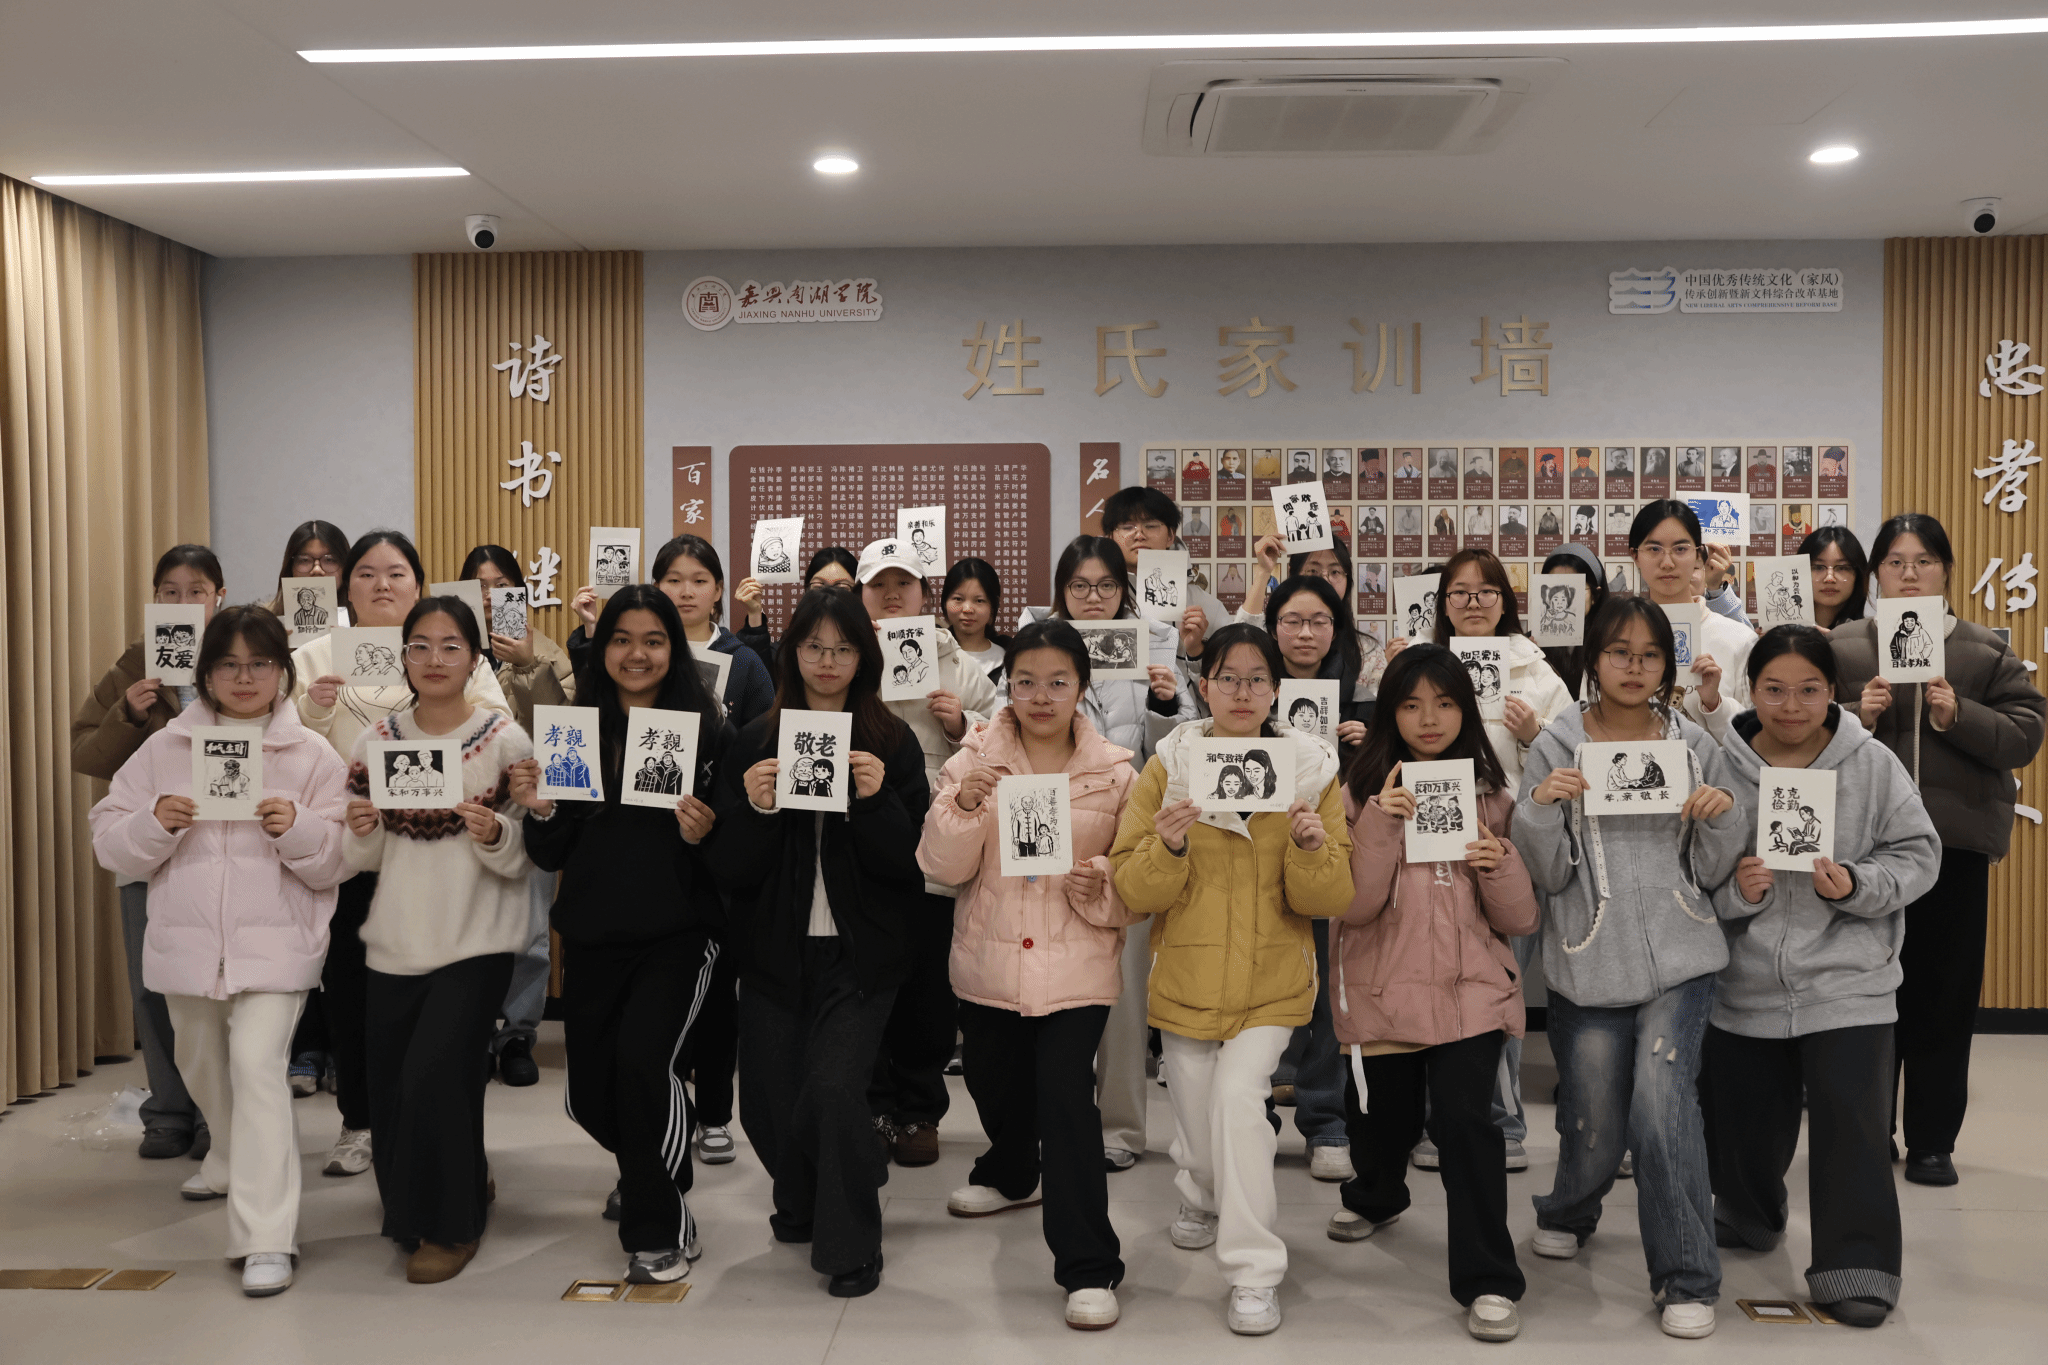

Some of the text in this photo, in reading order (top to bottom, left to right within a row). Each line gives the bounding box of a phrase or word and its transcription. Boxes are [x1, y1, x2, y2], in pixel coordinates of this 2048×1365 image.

[1685, 288, 1839, 299] 传承创新暨新文科综合改革基地
[739, 308, 878, 319] JIAXING NANHU UNIVERSITY
[962, 315, 1553, 401] 姓氏家训墙
[677, 462, 706, 525] 百家
[156, 646, 194, 668] 友爱
[1460, 650, 1500, 660] 知足常乐
[794, 732, 836, 757] 敬老
[1206, 752, 1244, 763] 和气致祥
[388, 788, 443, 797] 家和万事兴
[1415, 781, 1461, 794] 家和万事兴
[1604, 790, 1669, 802] 孝亲敬长
